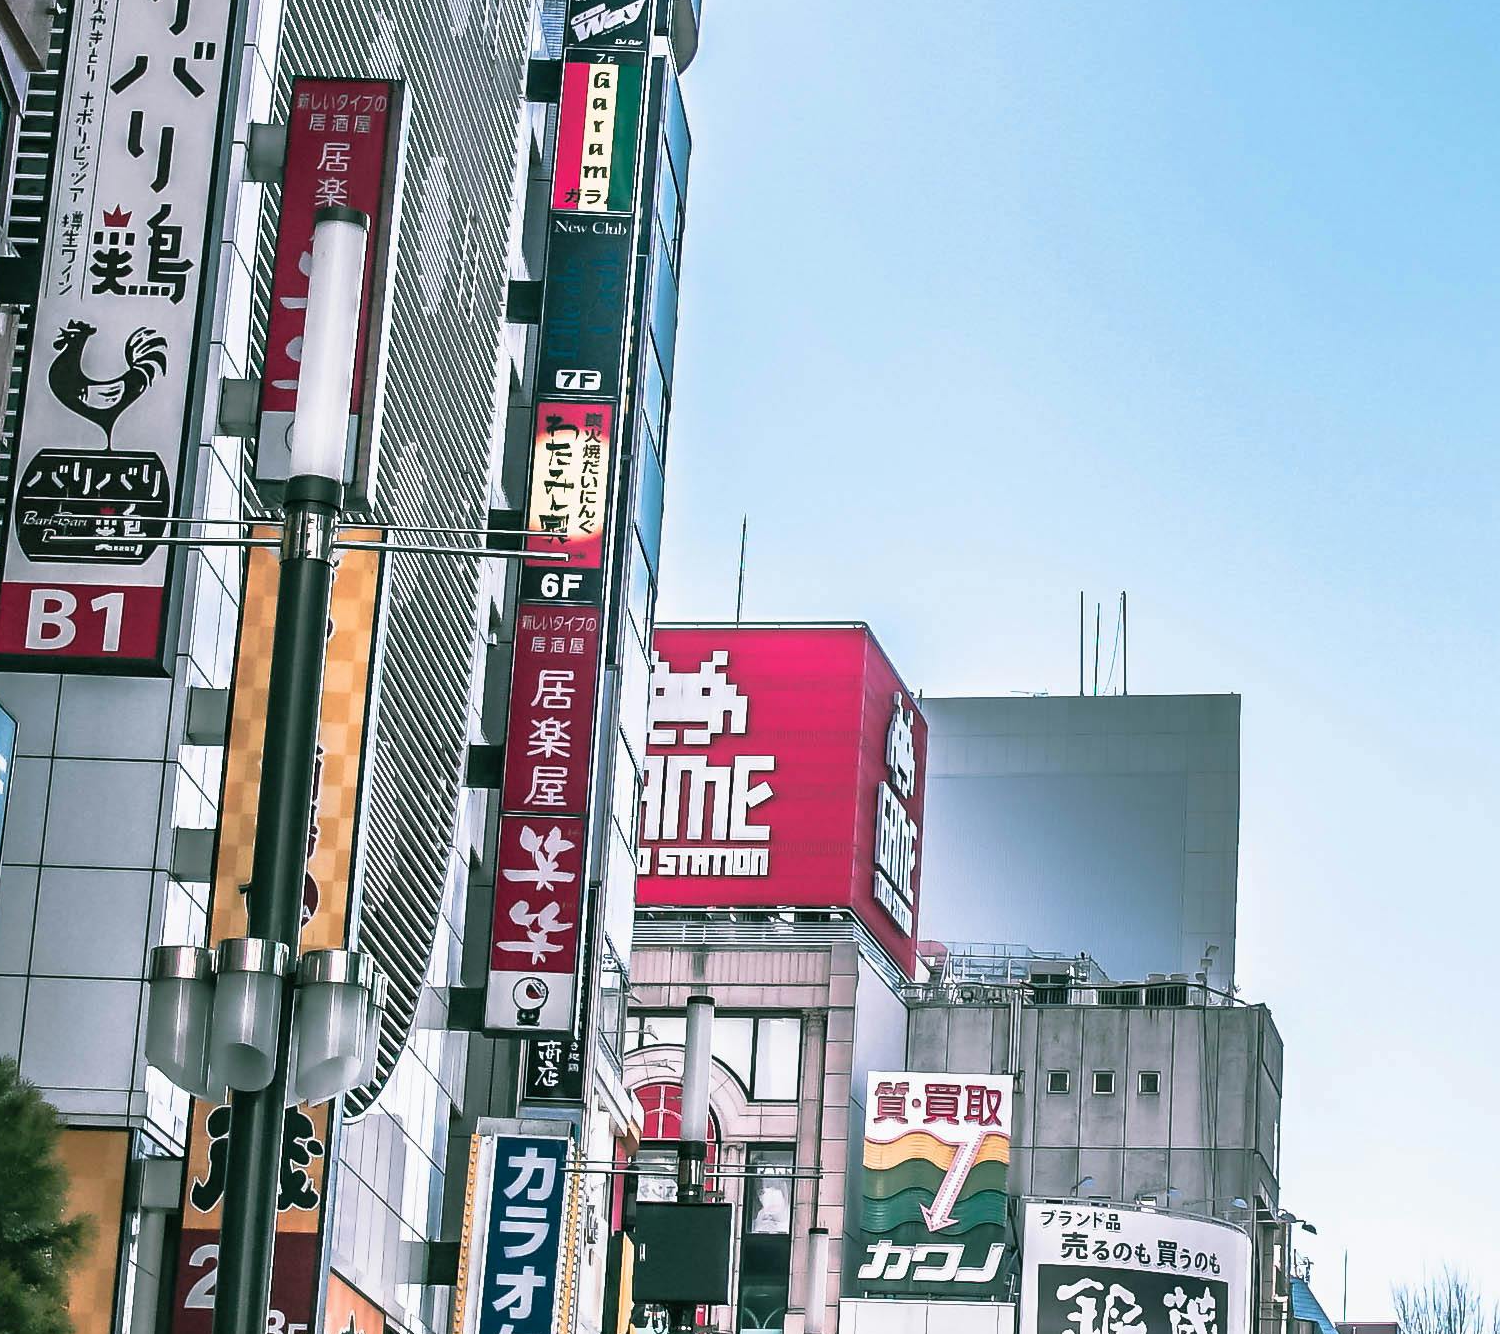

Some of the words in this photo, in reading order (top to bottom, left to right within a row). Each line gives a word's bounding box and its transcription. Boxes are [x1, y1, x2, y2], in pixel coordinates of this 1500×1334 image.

[296, 93, 387, 113] 新しいタイプの
[308, 113, 371, 134] 居酒屋
[582, 71, 611, 179] Garam
[555, 220, 586, 235] New
[591, 220, 628, 236] Club
[560, 371, 598, 389] 7F
[26, 461, 162, 498] バリバリ
[540, 572, 583, 598] 6F
[24, 588, 125, 652] B1
[522, 615, 597, 632] 新しいタイプの
[530, 636, 585, 655] 居酒屋
[523, 669, 576, 806] 居楽屋
[657, 847, 770, 876] STATION
[1038, 1209, 1122, 1231] ブランド品
[857, 1239, 1006, 1283] カワノ
[1060, 1231, 1221, 1275] 売るのも買うのも
